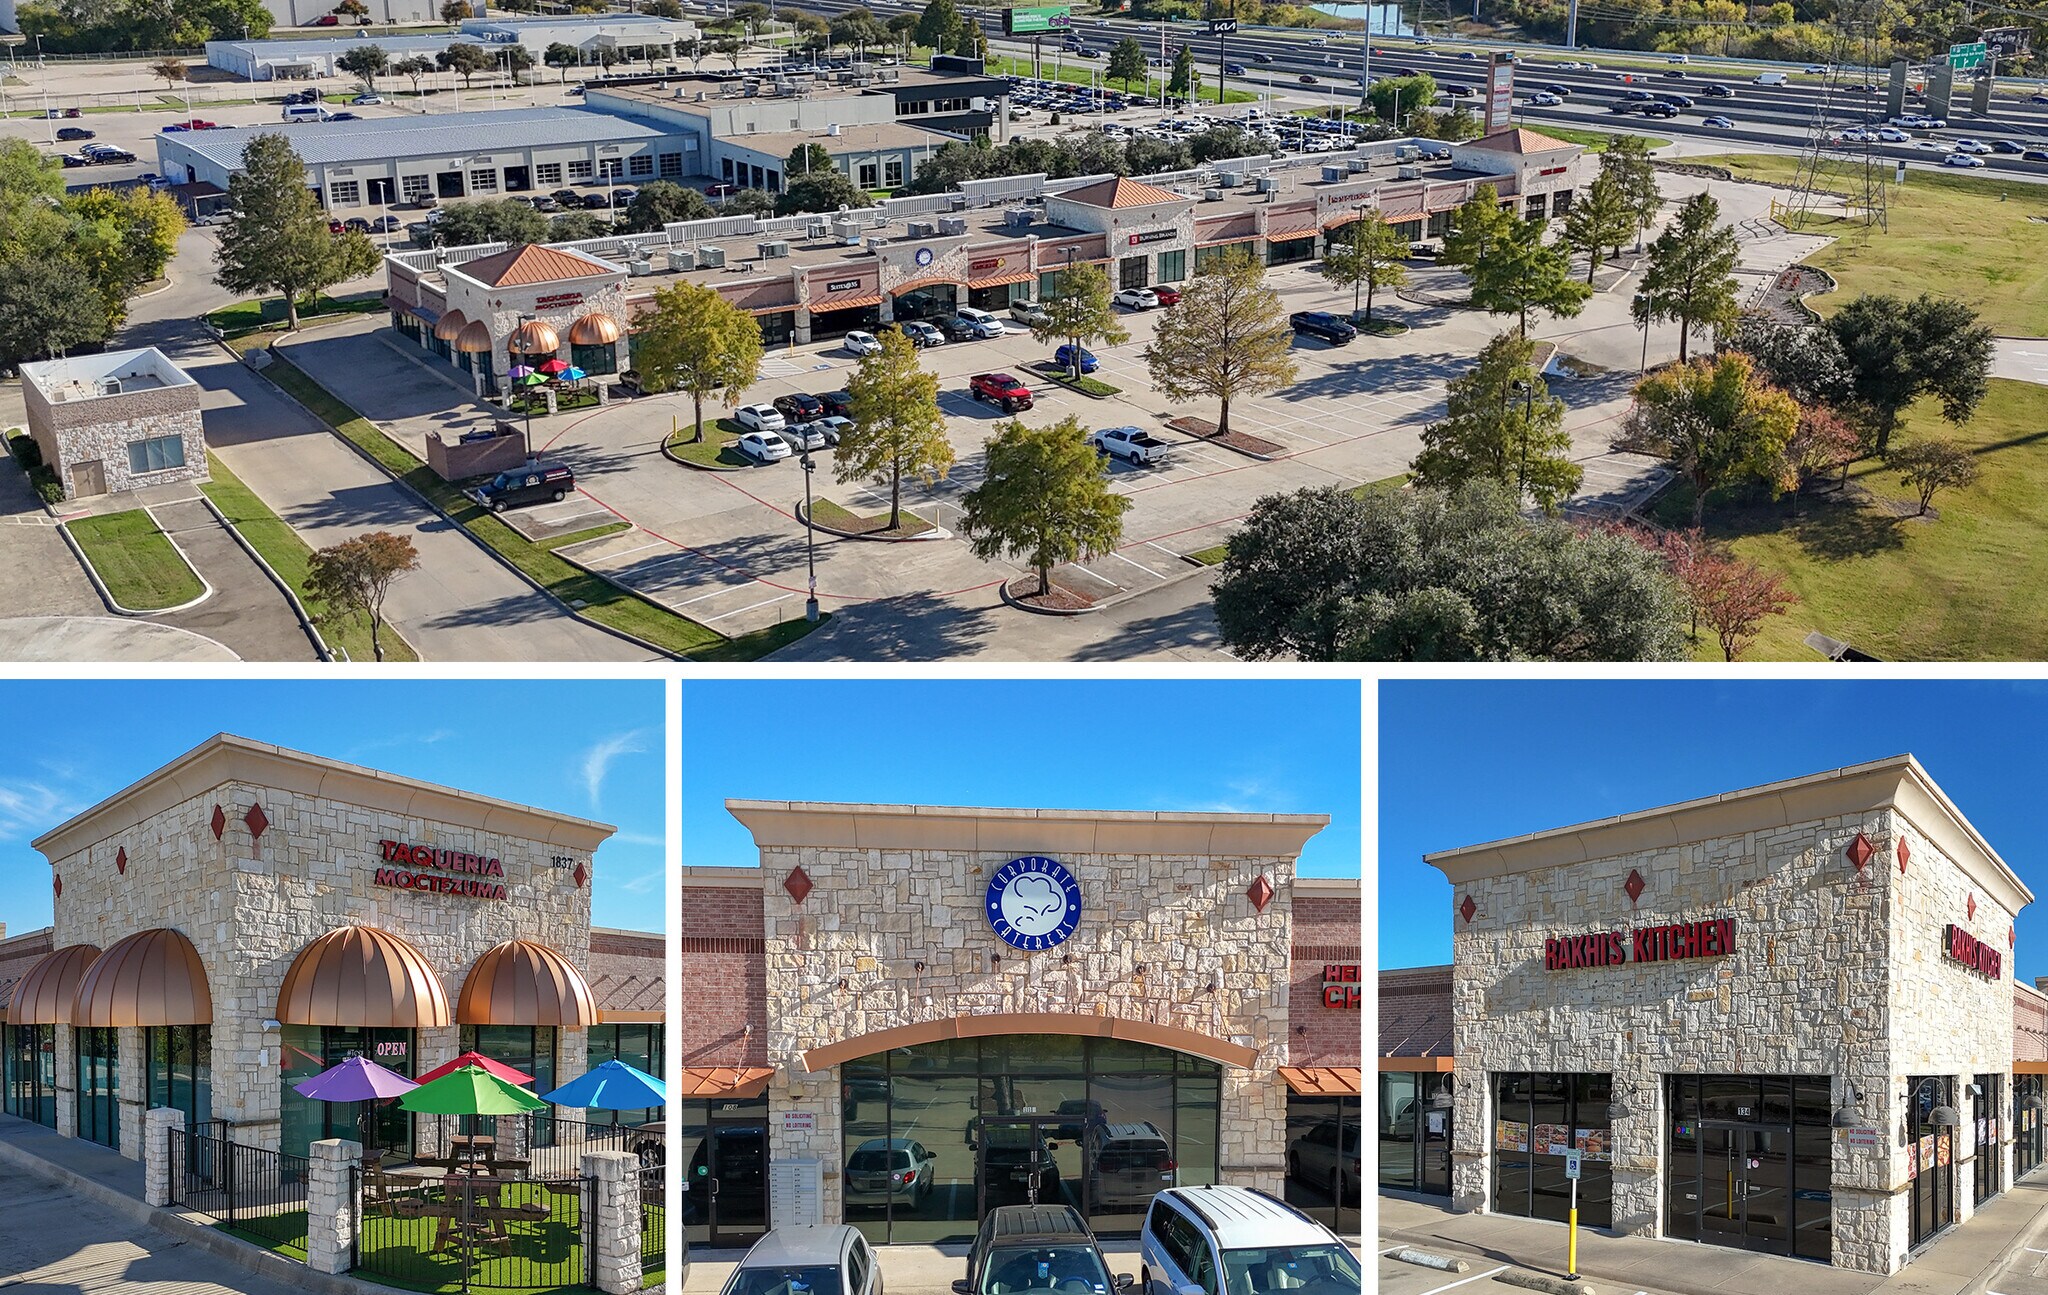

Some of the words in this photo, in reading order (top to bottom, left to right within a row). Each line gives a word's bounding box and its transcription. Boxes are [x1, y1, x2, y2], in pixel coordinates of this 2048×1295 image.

[379, 839, 504, 878] TAQUERIA
[551, 855, 573, 870] 1837
[991, 857, 1077, 893] CORPORATE
[375, 867, 507, 900] MOCTEZUMA
[993, 917, 1074, 950] CATERERS
[1545, 931, 1626, 970] RAKHIS
[1633, 917, 1735, 963] KITCHEN
[1949, 924, 1977, 969] RAKHIS
[1979, 941, 2001, 980] KITCHEN
[377, 1042, 407, 1056] OPEN
